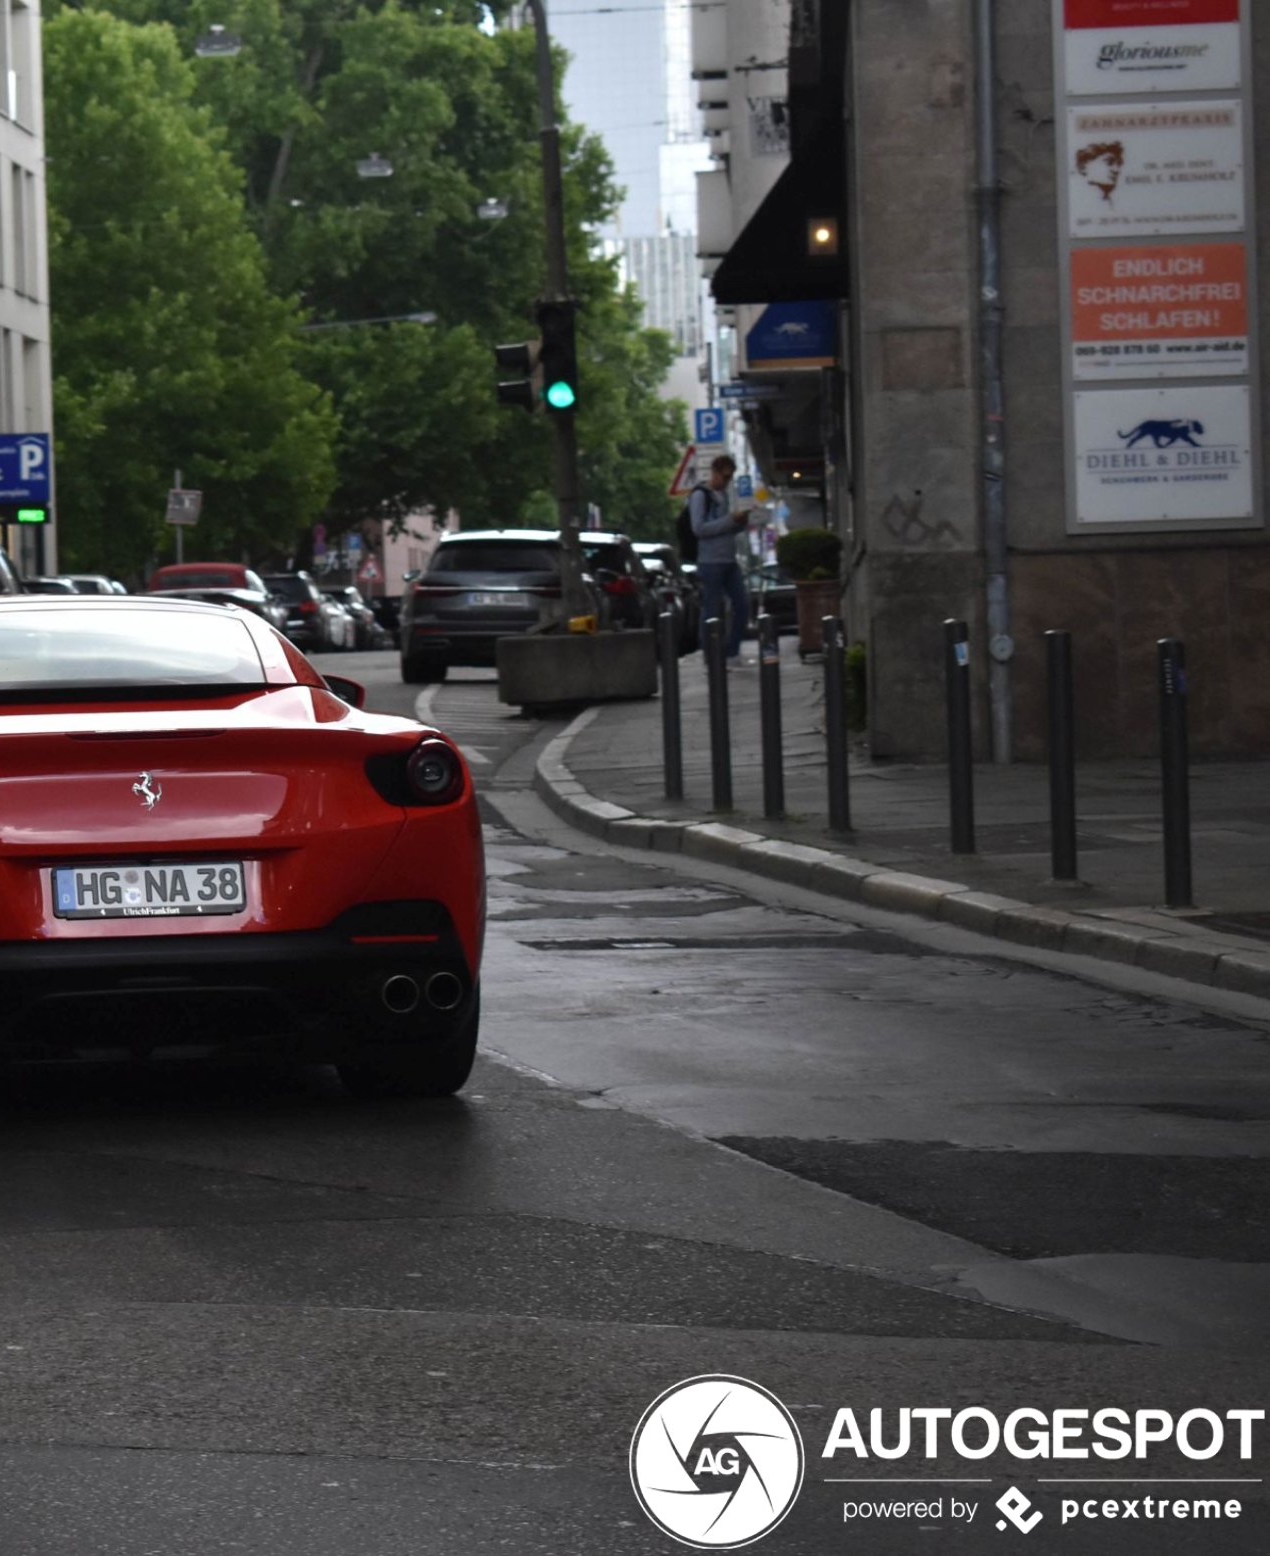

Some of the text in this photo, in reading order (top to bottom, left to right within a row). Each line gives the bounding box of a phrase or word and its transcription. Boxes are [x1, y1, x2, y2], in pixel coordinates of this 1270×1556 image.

[1113, 257, 1204, 278] ENDLICH
[1077, 282, 1241, 305] SCHNARCHFREI
[700, 412, 718, 439] P
[20, 444, 44, 480] P
[1086, 449, 1242, 470] DIEHL & DIEHL
[76, 871, 122, 906] HG
[144, 868, 190, 903] NA
[196, 867, 239, 901] 38
